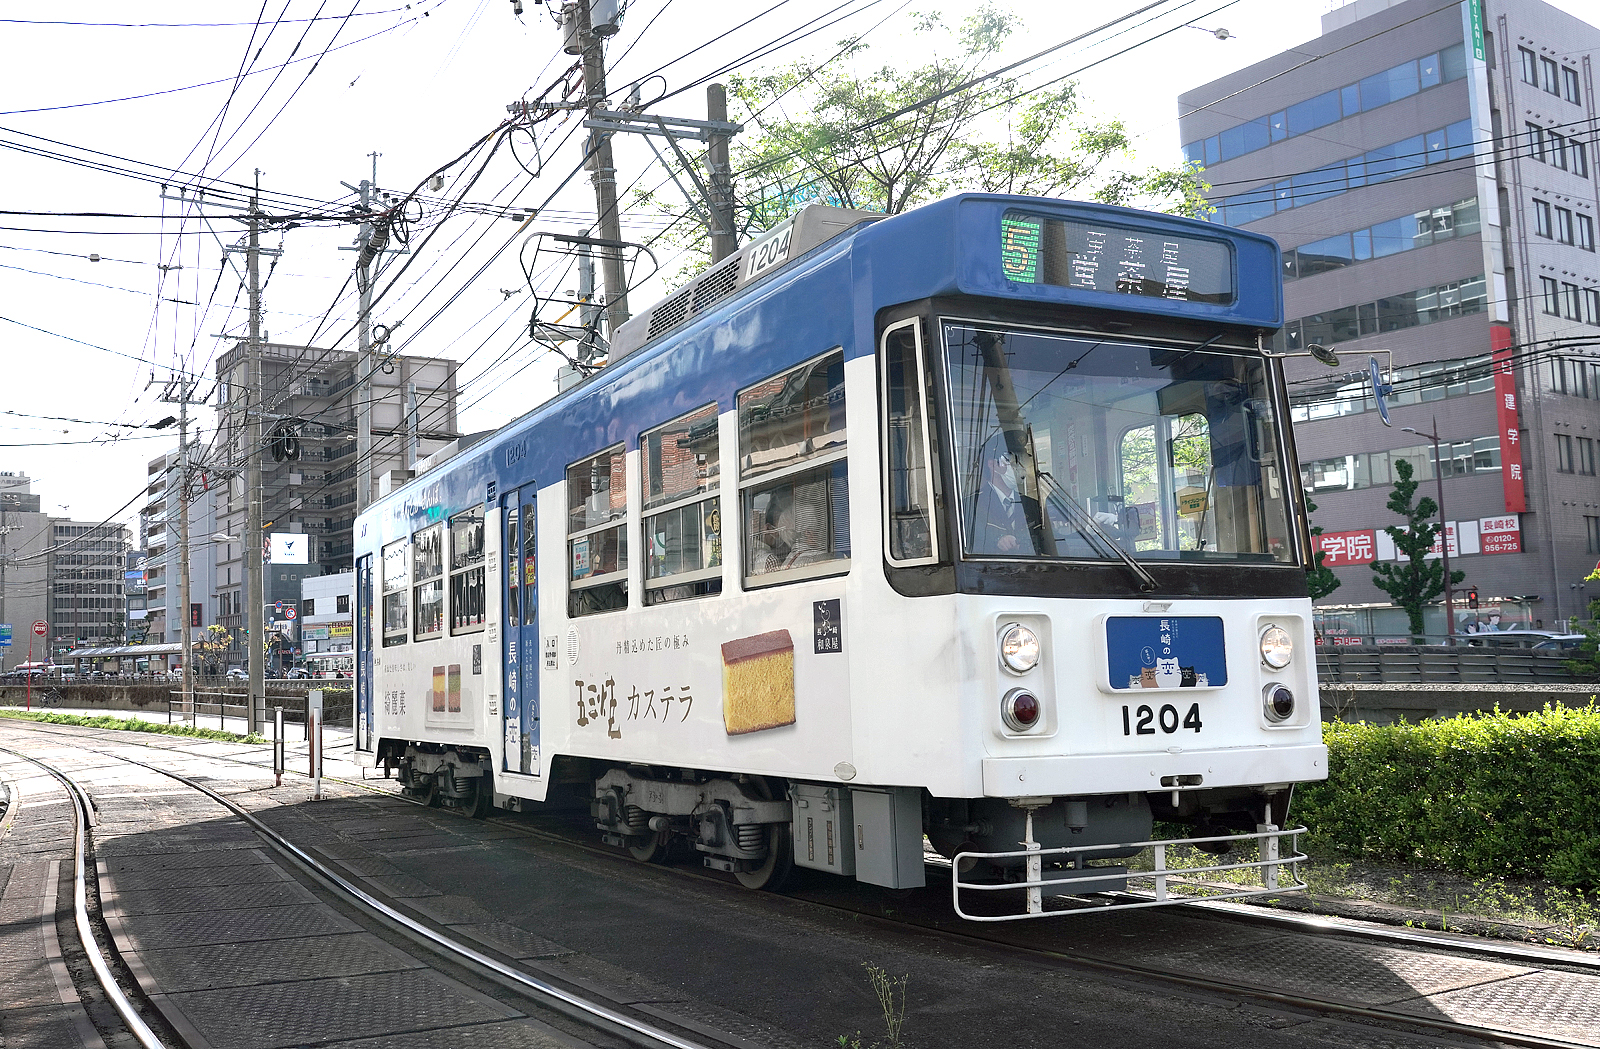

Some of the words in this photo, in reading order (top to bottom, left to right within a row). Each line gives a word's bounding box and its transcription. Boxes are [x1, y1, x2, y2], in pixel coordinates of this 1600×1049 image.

[749, 229, 790, 276] 1204
[1004, 226, 1030, 274] 5
[505, 442, 527, 468] 1204
[1483, 519, 1516, 531] 長崎校
[1494, 535, 1515, 544] 0120-
[1321, 534, 1373, 563] 学院
[1484, 542, 1518, 552] 956-725
[615, 634, 690, 655] 丹精込めた匠の極み
[1159, 619, 1171, 655] 長崎の
[508, 641, 518, 712] 長崎の
[626, 684, 694, 724] カステラ
[1121, 702, 1203, 736] 1204
